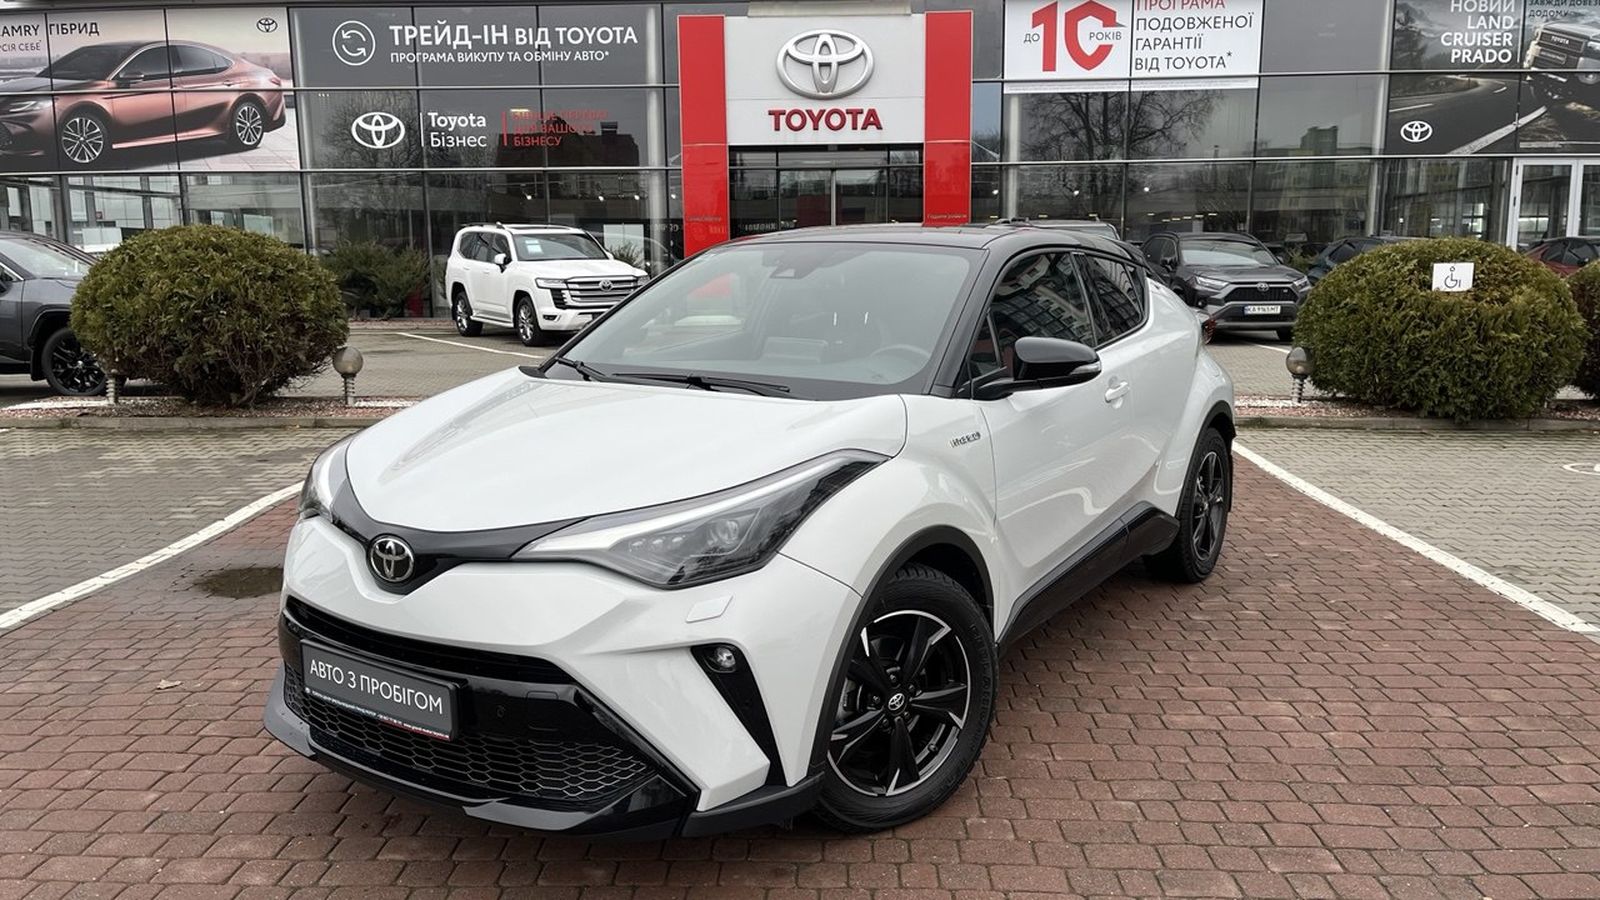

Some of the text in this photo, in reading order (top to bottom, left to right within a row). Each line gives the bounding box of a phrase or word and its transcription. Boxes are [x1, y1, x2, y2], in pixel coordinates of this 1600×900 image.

[1136, 0, 1225, 10] ПРОГРАМА
[0, 22, 100, 36] AMRY ГІБРИД
[1136, 12, 1255, 32] ПОДОВЖЕНОЇ
[1467, 15, 1514, 30] LAND
[389, 20, 638, 49] ТРЕЙД-ІН ВІД TOYOTA
[1023, 33, 1040, 44] ДО
[1089, 31, 1122, 41] РОКІВ
[1135, 34, 1202, 50] ГАРАНТІЇ
[1441, 32, 1513, 47] CRUISER
[390, 51, 454, 63] ПРОГРАМА
[457, 51, 505, 63] ВИКУПУ
[507, 51, 521, 62] ТА
[523, 50, 571, 62] ОБМІНУ
[1450, 48, 1512, 63] PRADO
[1135, 57, 1160, 72] ВІД
[428, 112, 486, 131] Toyota
[768, 108, 883, 132] TOYOTA
[430, 132, 487, 148] Бізнес
[513, 136, 562, 147] БІЗНЕСУ
[310, 659, 344, 684] АВТО
[360, 674, 443, 715] ПРОБІГОМ
